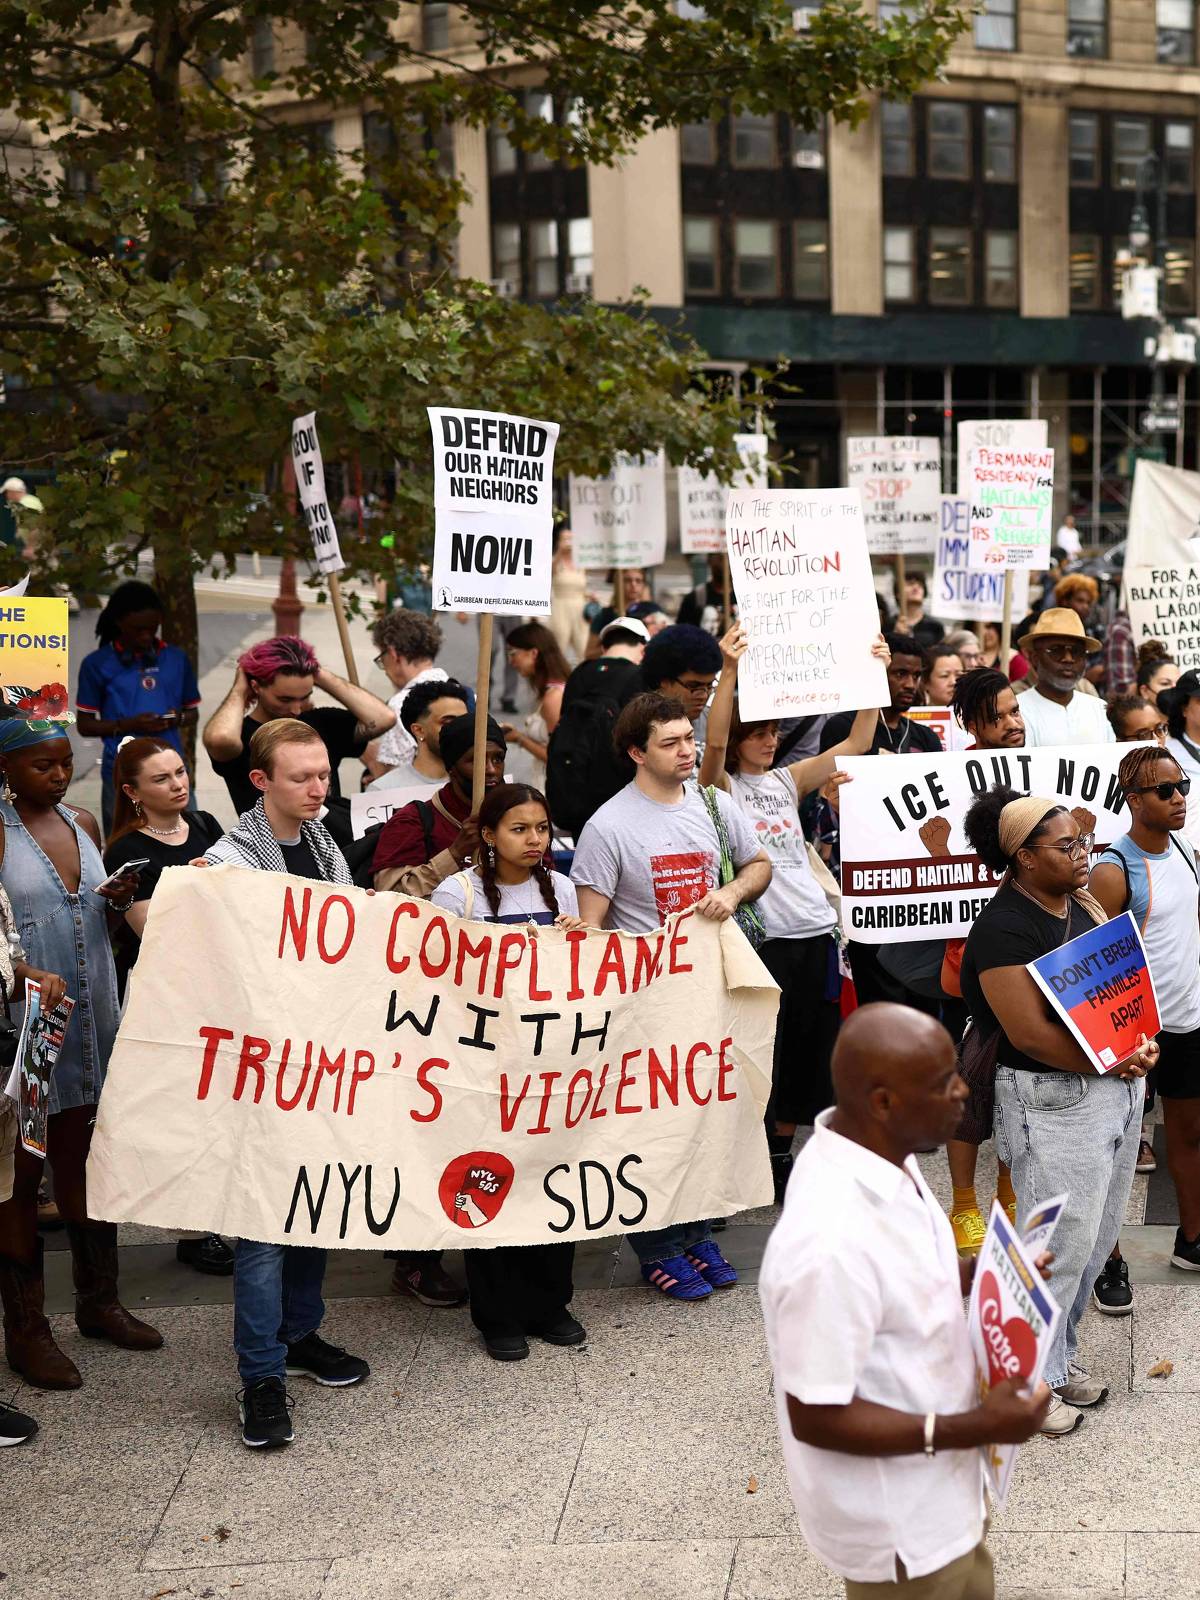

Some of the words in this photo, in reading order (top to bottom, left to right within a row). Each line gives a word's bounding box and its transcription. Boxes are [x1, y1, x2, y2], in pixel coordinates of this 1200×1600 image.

[440, 415, 547, 457] DEFEND
[444, 451, 481, 474] OUR
[979, 449, 1053, 469] PERMANENT
[450, 477, 538, 505] NEIGHORS
[864, 479, 912, 499] STOP
[975, 467, 1037, 491] RESIDENCY
[981, 486, 1050, 506] HAITIANS
[731, 501, 744, 519] IN
[752, 499, 773, 518] THE
[780, 500, 817, 518] SPIRIT
[841, 504, 858, 516] THE
[972, 506, 994, 519] AND
[731, 525, 796, 556] HAITIAN
[972, 526, 990, 541] TPS
[451, 533, 533, 576] NOW!
[744, 551, 840, 581] REVOLUTION
[984, 553, 1005, 564] FSP
[1152, 568, 1181, 584] FOR
[1188, 567, 1198, 580] A
[454, 596, 483, 605] CARIBBEAN
[792, 588, 815, 605] FOR
[818, 586, 849, 603] THE
[0, 607, 25, 622] HE
[744, 611, 798, 638] DEFEAT
[810, 608, 833, 628] OF
[0, 633, 67, 652] TIONS!
[744, 642, 837, 674] IMPERIALISM
[754, 668, 830, 688] EVERYWHERE
[882, 771, 950, 832] ICE
[965, 755, 1032, 794] OUT
[1056, 758, 1127, 815] NOW
[662, 869, 673, 877] ICE
[852, 867, 912, 890] DEFEND
[916, 862, 973, 887] HAITIAN
[977, 864, 988, 882] &
[851, 902, 952, 929] CARIBBEAN
[278, 886, 355, 964] NO
[386, 902, 694, 1001] COMPLIANE
[1048, 952, 1103, 994] DON'T
[1101, 933, 1141, 967] BREAK
[385, 989, 612, 1056] WITH
[1110, 995, 1145, 1033] APART
[197, 1026, 449, 1122] TRUMP'S
[500, 1037, 738, 1135] VIOLENCE
[471, 1169, 496, 1181] NYU
[478, 1180, 499, 1193] SDS
[284, 1162, 401, 1239] NYU
[543, 1153, 648, 1233] SDS
[990, 1238, 1044, 1338] HAITIANS
[979, 1296, 1022, 1377] Care
